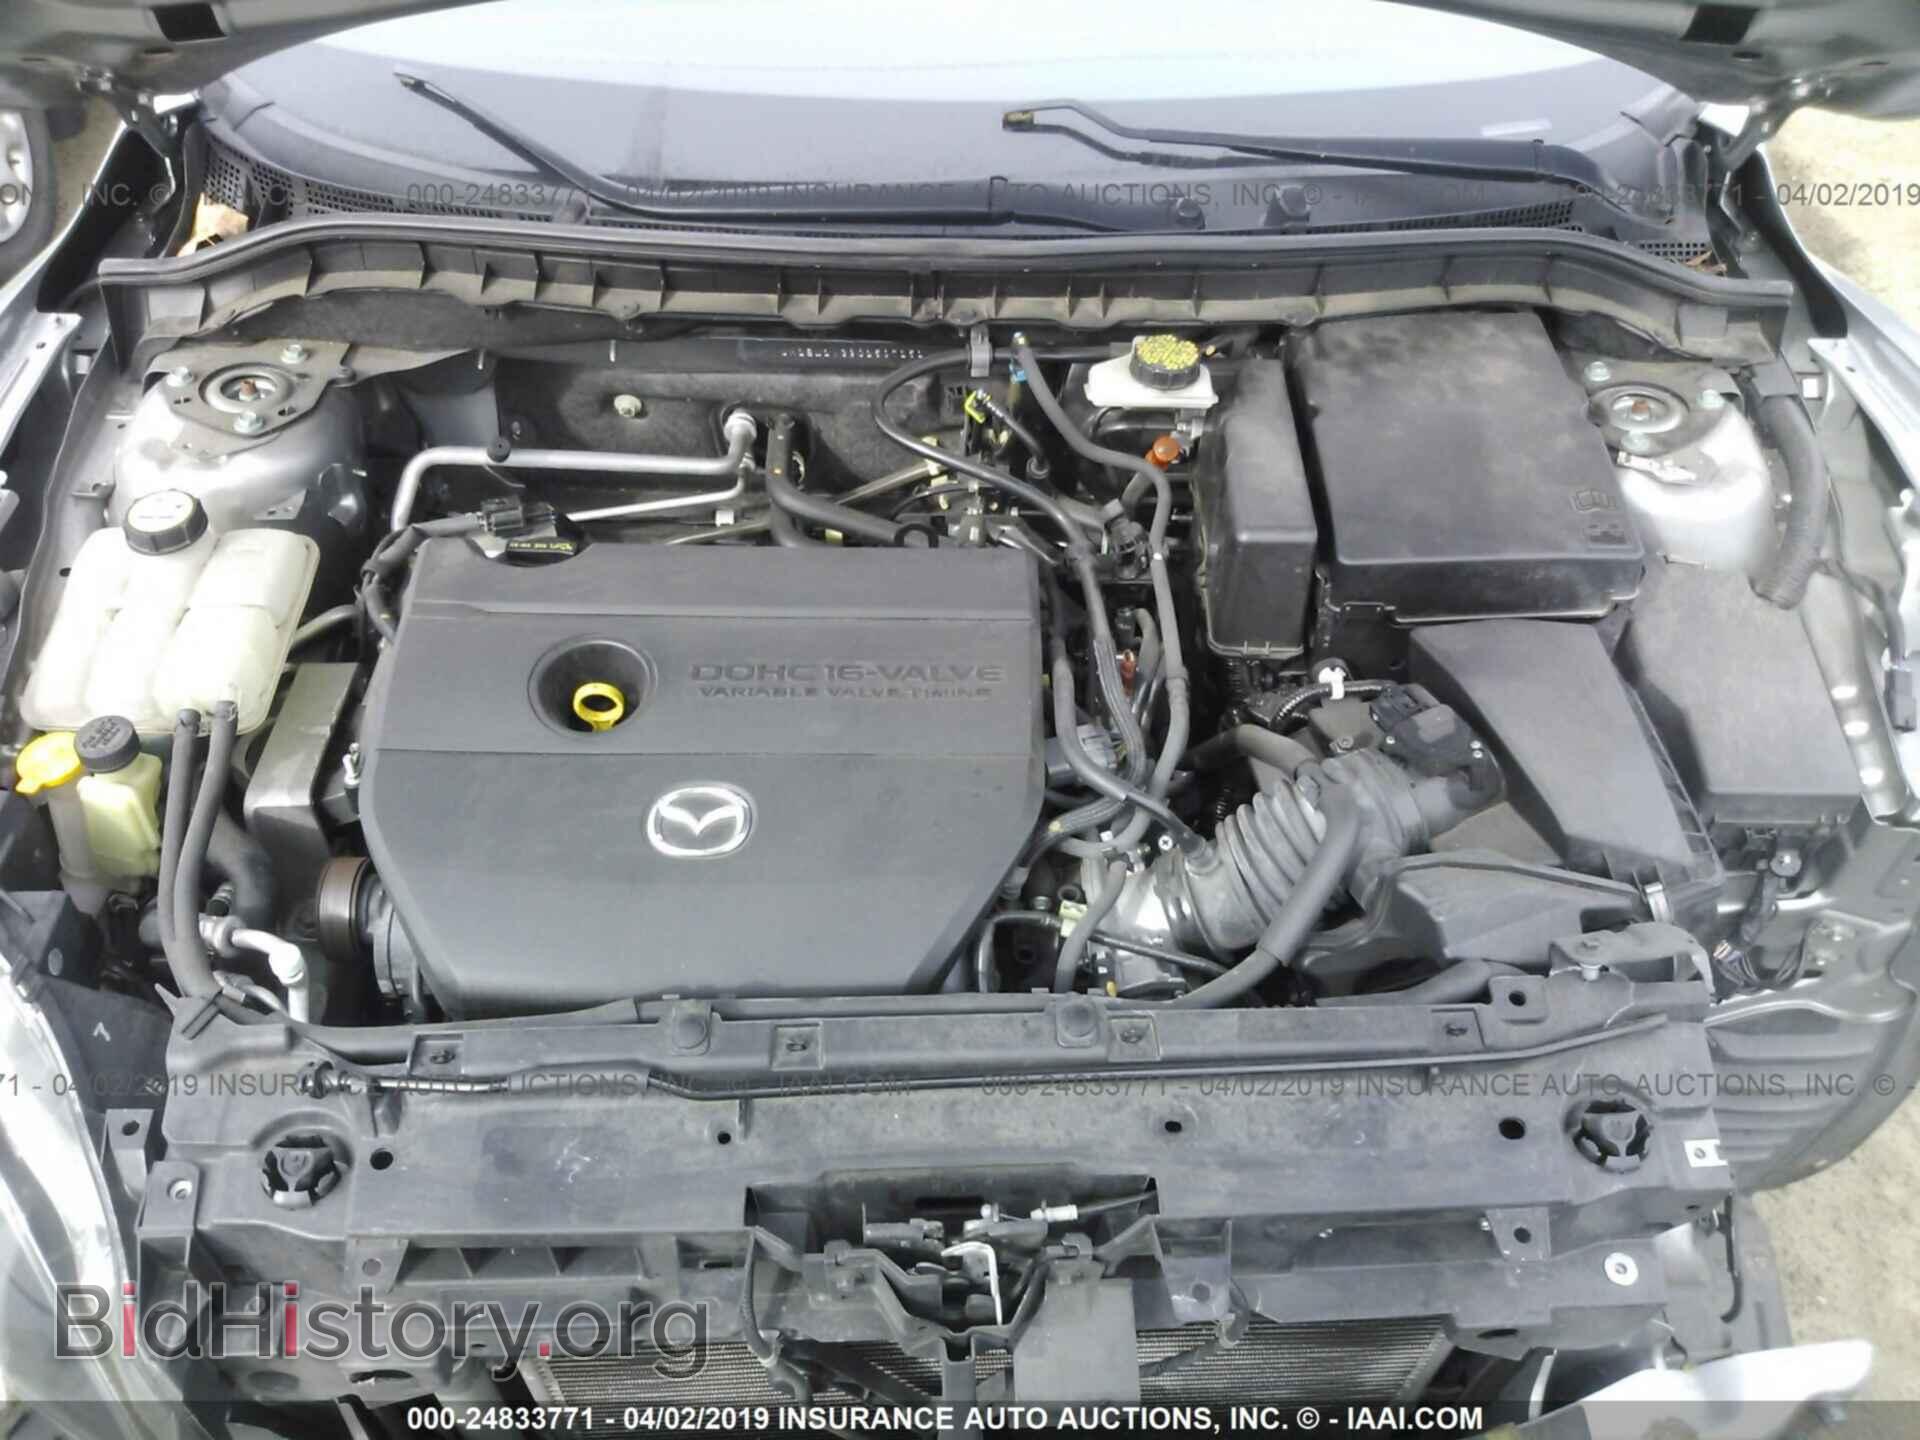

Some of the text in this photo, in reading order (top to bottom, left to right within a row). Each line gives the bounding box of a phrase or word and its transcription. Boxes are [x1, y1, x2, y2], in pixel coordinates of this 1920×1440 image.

[691, 664, 1003, 682] DOHC 16-VALVE
[700, 687, 817, 698] VARIABLE
[827, 687, 897, 698] VALVE
